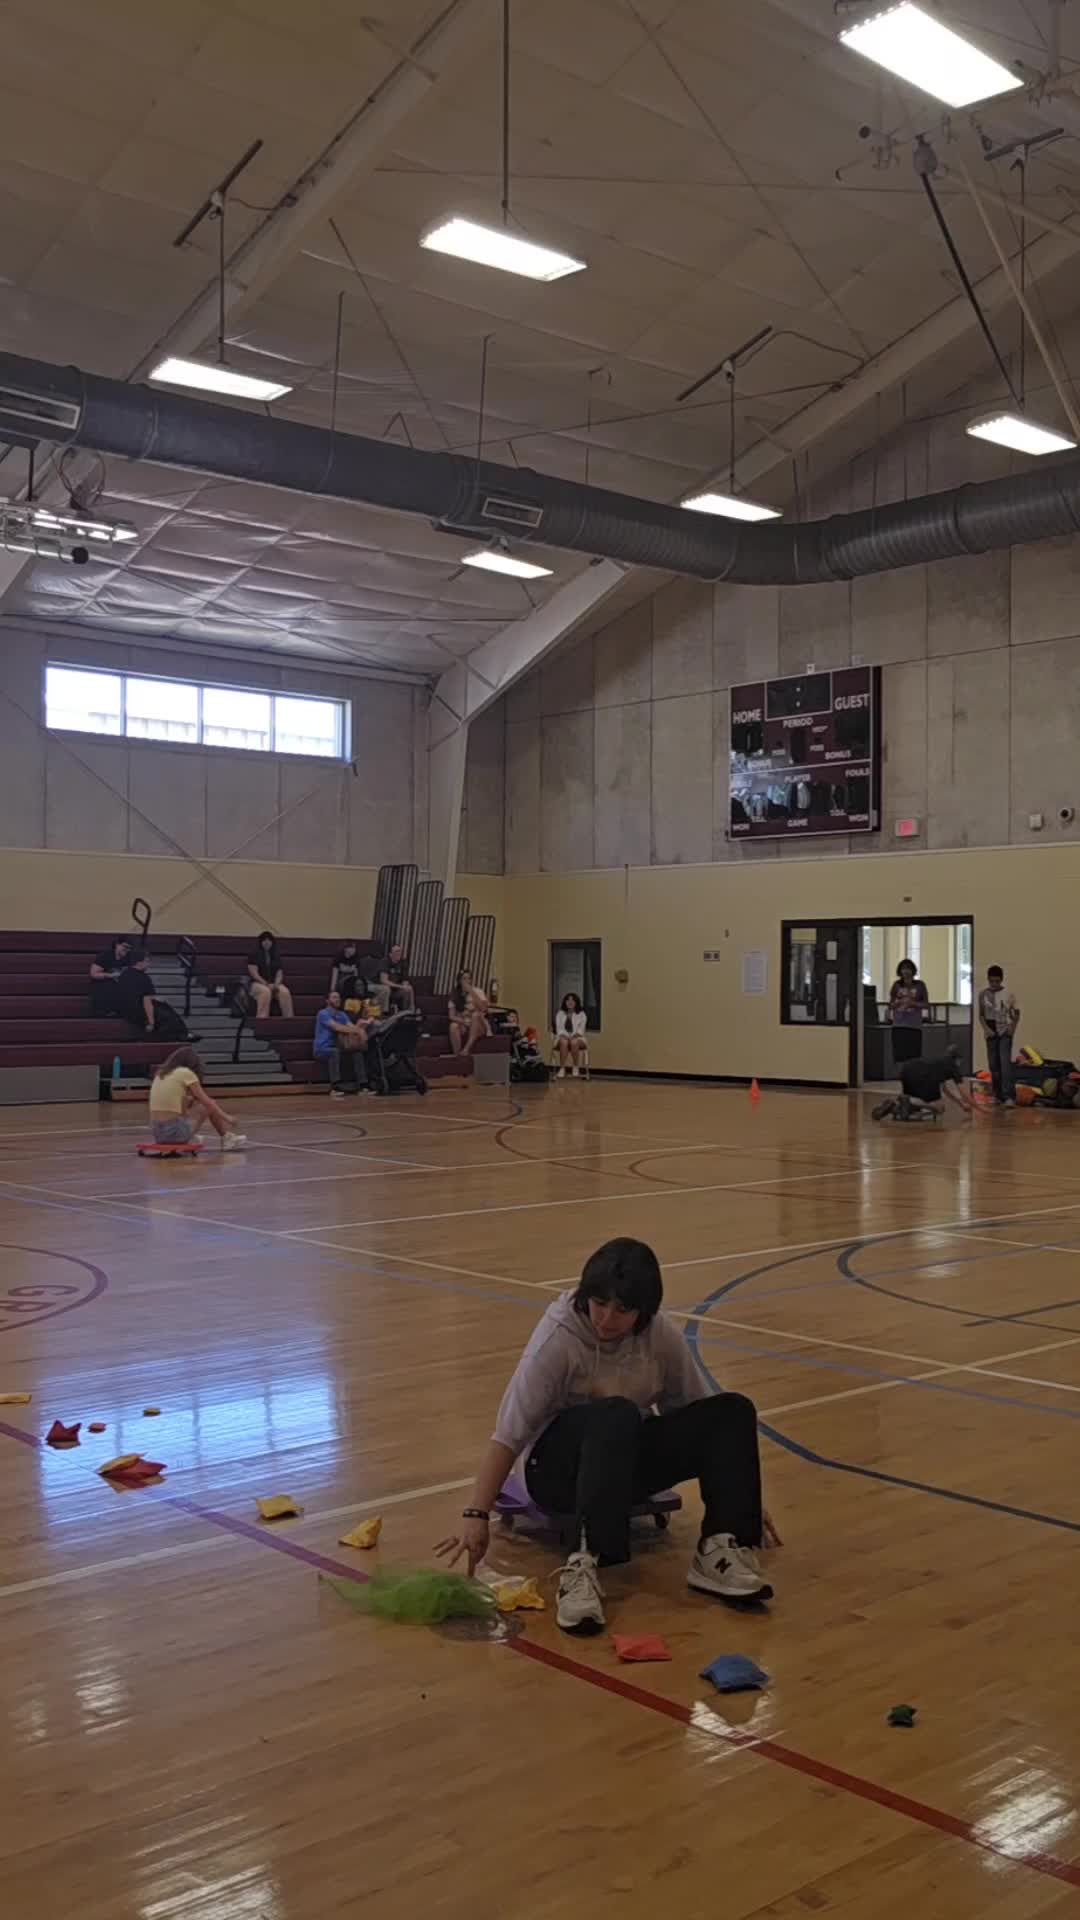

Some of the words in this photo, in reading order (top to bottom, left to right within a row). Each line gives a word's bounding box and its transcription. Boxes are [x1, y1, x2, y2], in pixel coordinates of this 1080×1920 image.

[834, 694, 869, 710] GUEST
[733, 709, 761, 724] HOME
[783, 717, 813, 728] PERIOD
[825, 751, 851, 760] BONUS
[845, 768, 870, 777] FOULS
[787, 818, 809, 827] GAME
[715, 1556, 733, 1575] N
